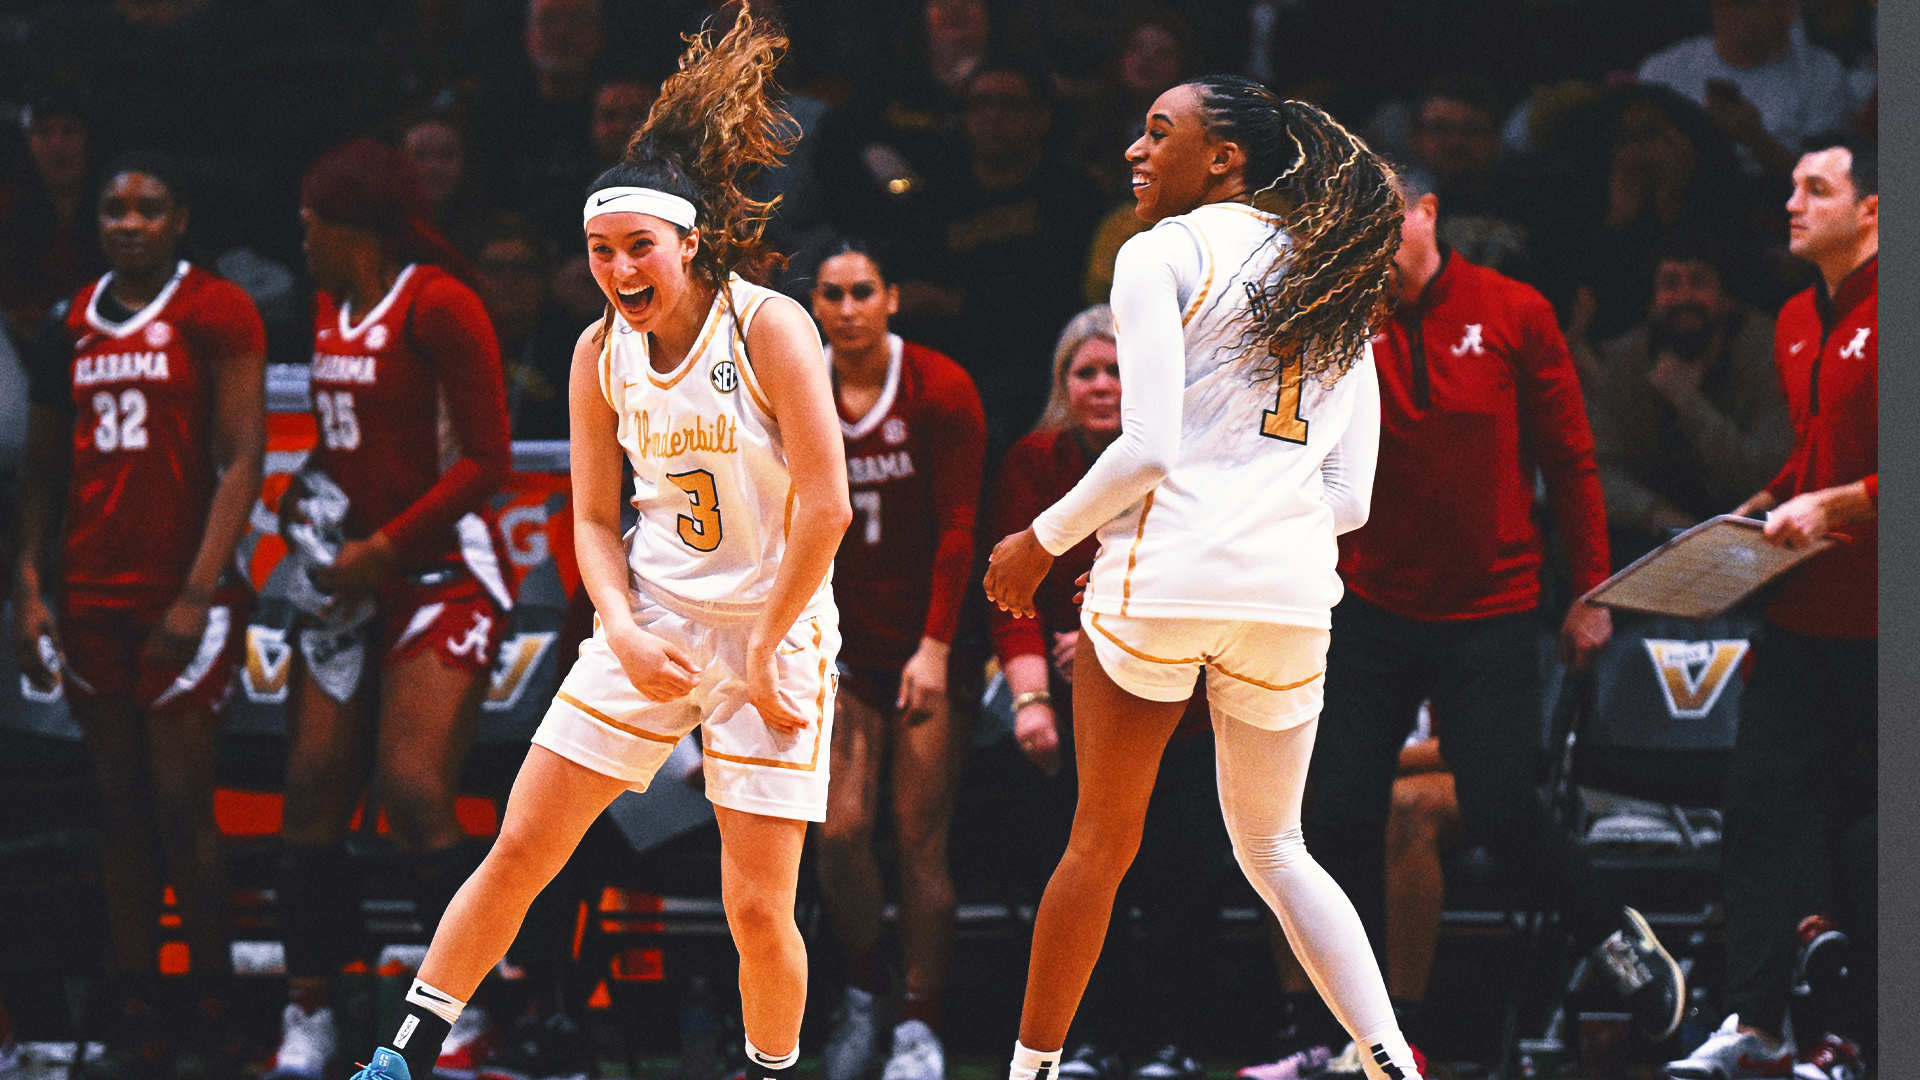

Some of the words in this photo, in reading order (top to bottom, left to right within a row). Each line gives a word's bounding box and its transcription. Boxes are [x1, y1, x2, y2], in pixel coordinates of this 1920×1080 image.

[93, 389, 149, 452] 32
[1259, 332, 1309, 446] 1
[634, 410, 738, 459] Vnderbilt
[666, 468, 723, 552] 3
[853, 492, 881, 543] 7
